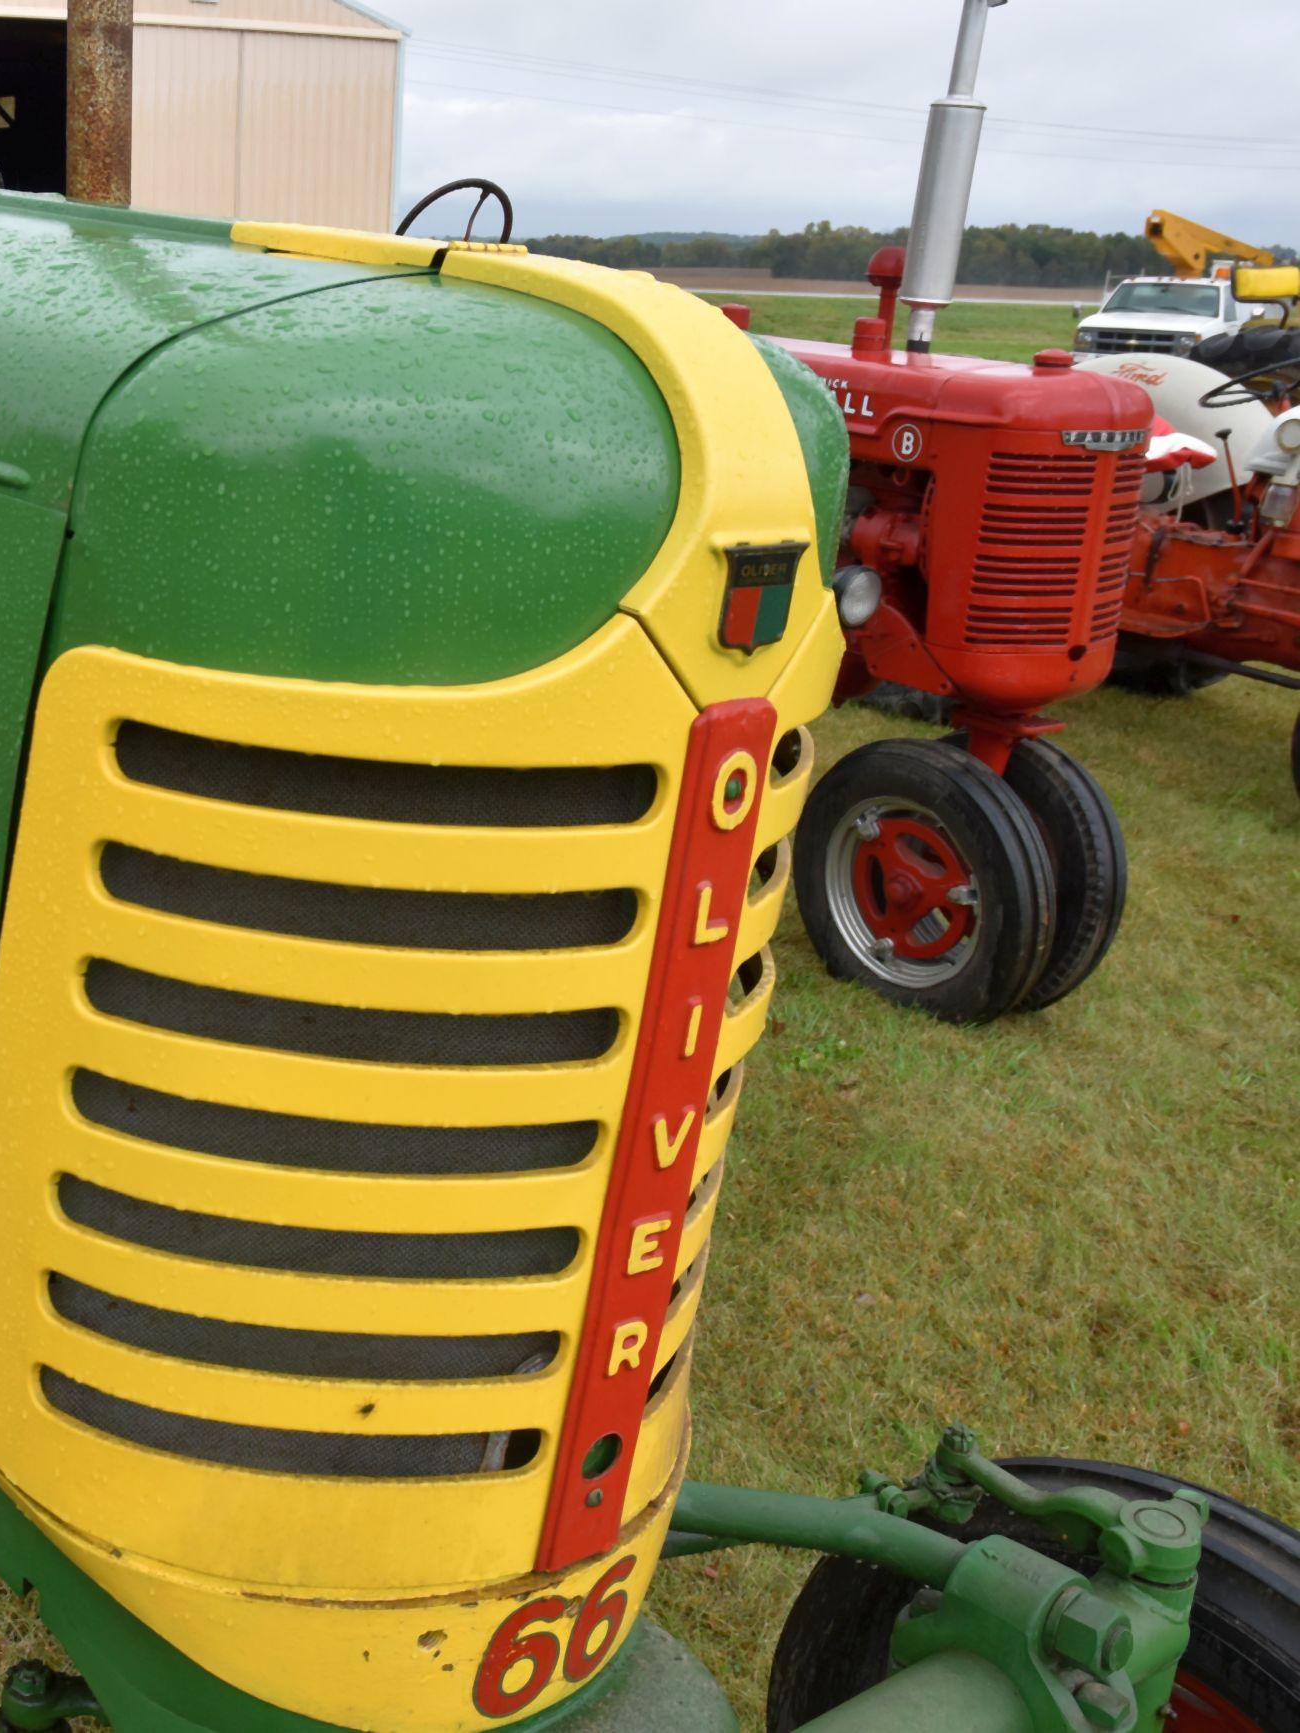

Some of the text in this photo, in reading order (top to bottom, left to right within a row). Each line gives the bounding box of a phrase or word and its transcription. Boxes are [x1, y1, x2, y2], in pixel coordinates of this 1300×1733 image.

[1112, 362, 1168, 386] Ford
[901, 431, 915, 455] B
[607, 751, 758, 1377] OLIVER
[472, 1554, 638, 1719] 66
